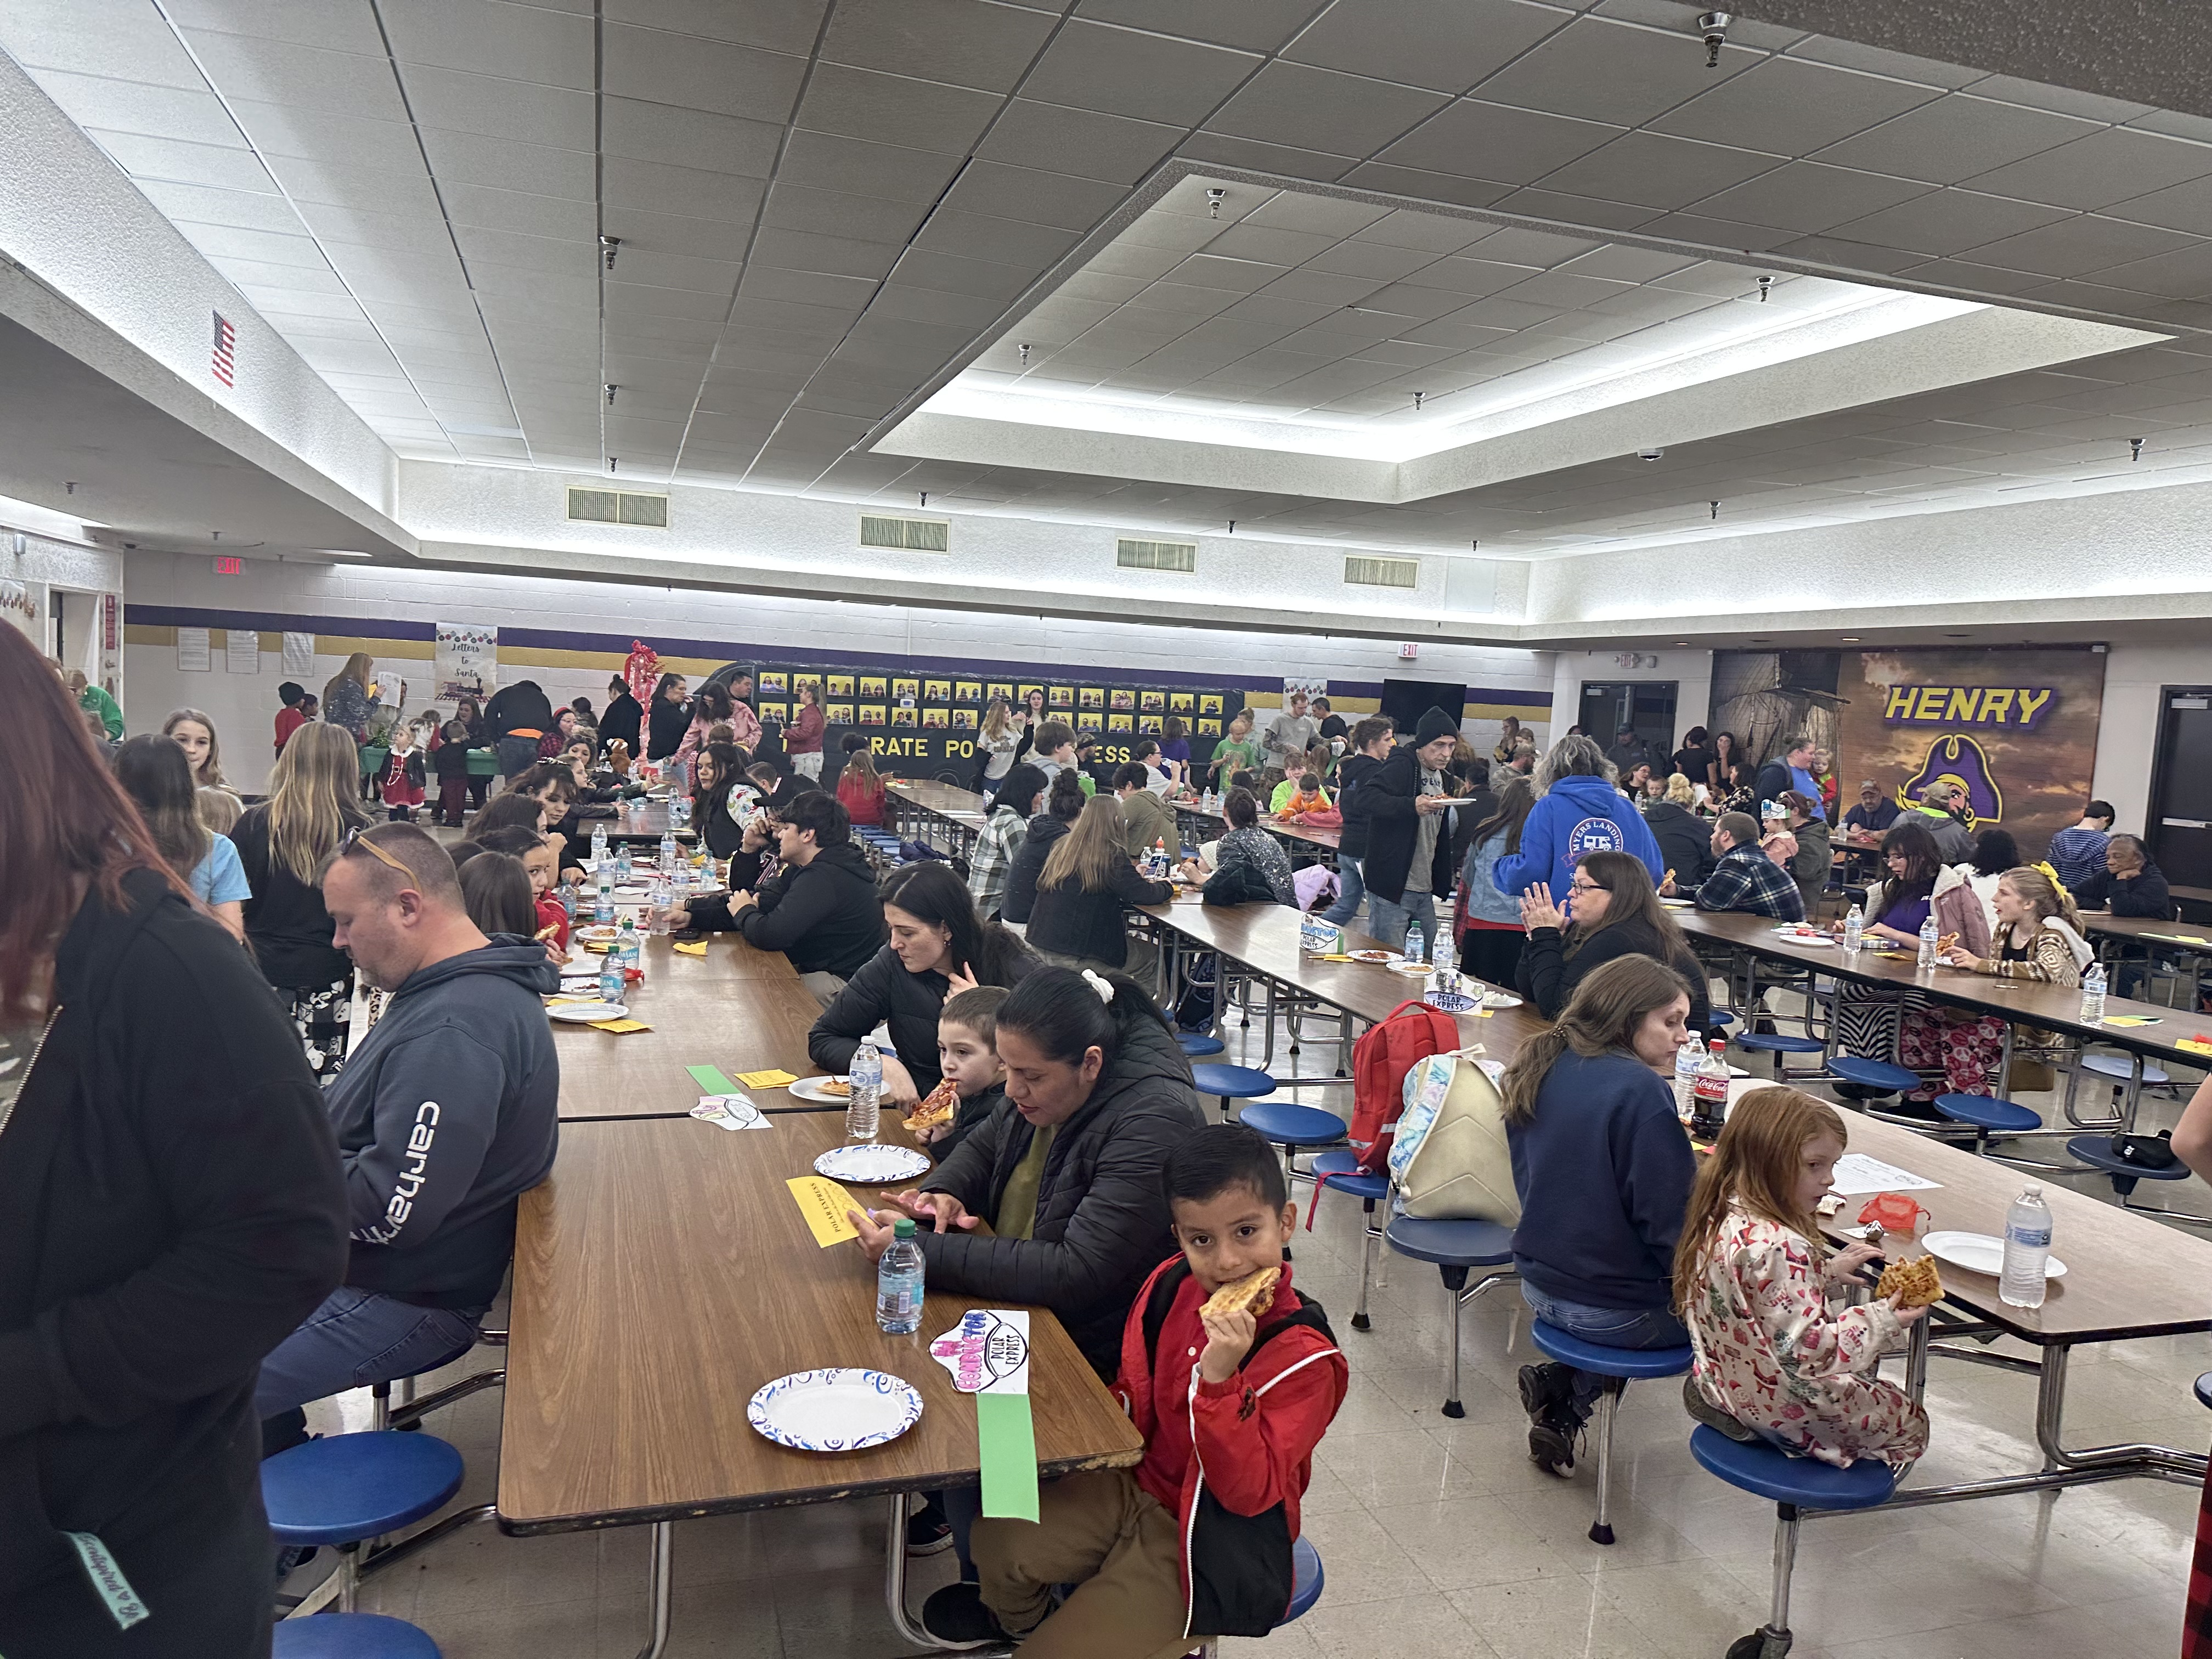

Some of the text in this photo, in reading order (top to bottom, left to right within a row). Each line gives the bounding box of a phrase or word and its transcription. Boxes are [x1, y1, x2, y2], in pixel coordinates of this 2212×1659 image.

[218, 557, 241, 574] EXIT
[451, 643, 479, 653] Letters
[1403, 644, 1419, 657] EXIT
[461, 656, 470, 665] to
[1620, 653, 1633, 668] EXIT
[454, 668, 479, 678] Santa
[1884, 686, 2053, 725] HENRY
[865, 736, 928, 757] RATE
[1572, 821, 1621, 851] MYERS LANDING
[1432, 1000, 1464, 1011] EXPRESS
[1437, 994, 1462, 1003] POLAR
[810, 1182, 829, 1210] EXPRESS
[826, 1210, 842, 1233] POLAR
[957, 1312, 986, 1389] CONDUCTOR
[990, 1336, 1006, 1359] POLAR
[1005, 1334, 1020, 1365] EXPRESS
